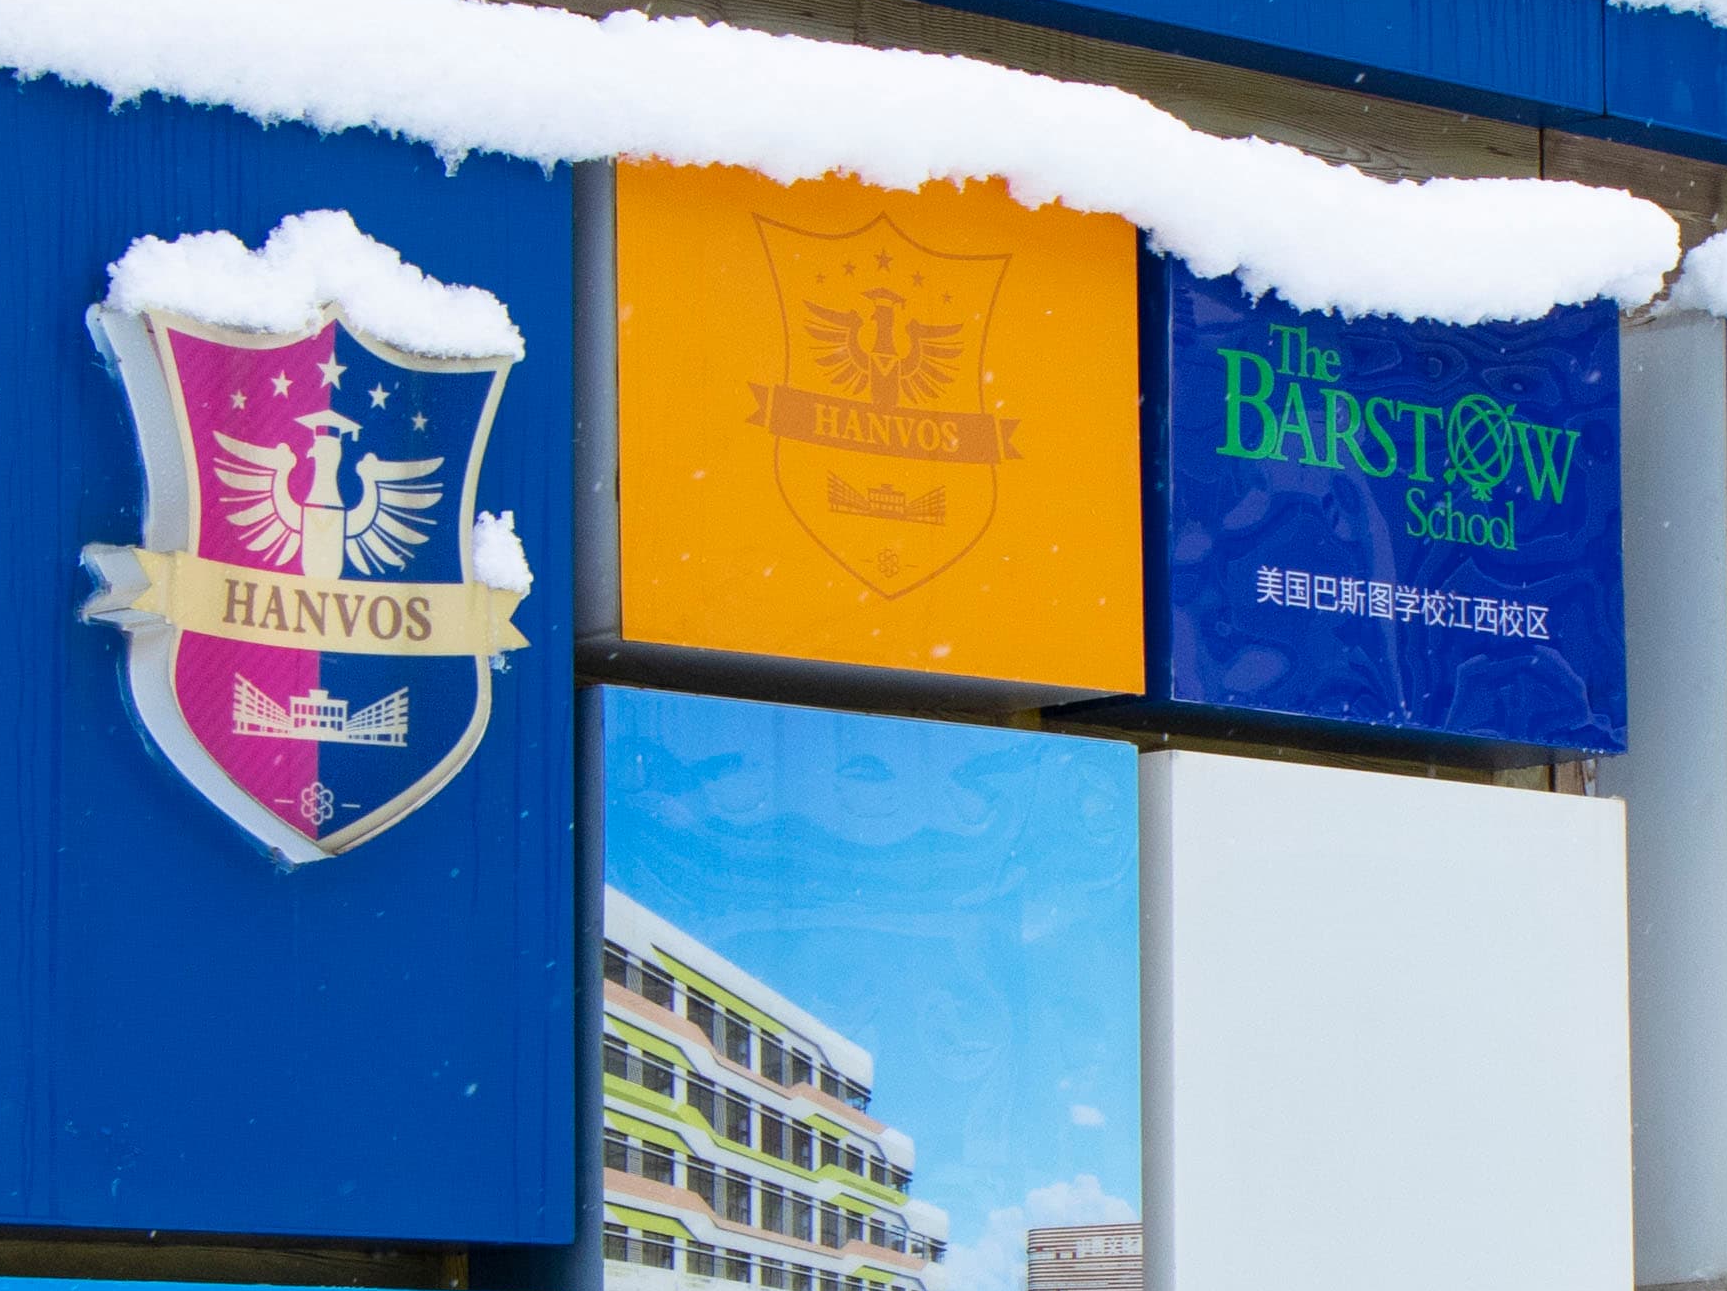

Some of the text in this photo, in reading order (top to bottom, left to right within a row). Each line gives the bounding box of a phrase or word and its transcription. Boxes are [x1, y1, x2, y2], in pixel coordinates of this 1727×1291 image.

[1269, 322, 1342, 383] The
[814, 402, 959, 454] HANVOS
[1216, 347, 1581, 506] BARSTOW
[1405, 487, 1518, 551] School
[221, 577, 432, 643] HANVOS
[1256, 565, 1551, 640] 美国巴斯图学校江西校区
